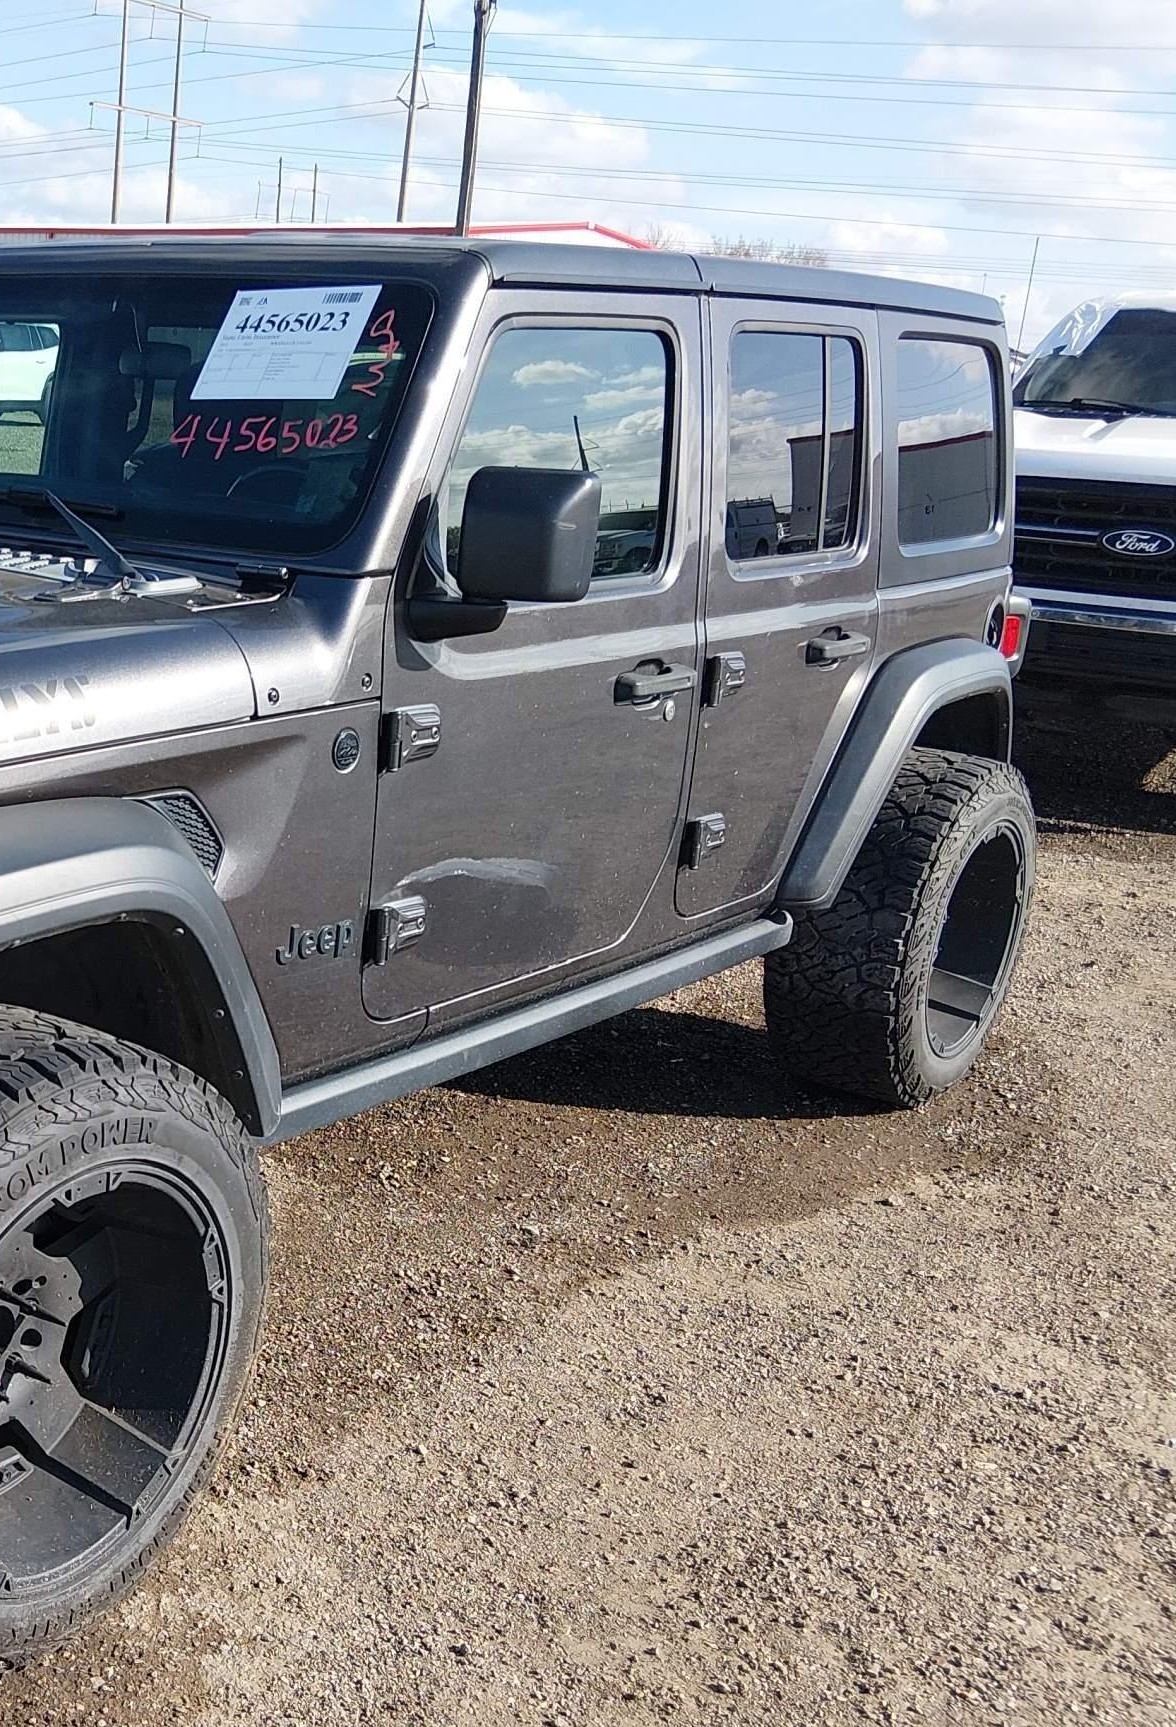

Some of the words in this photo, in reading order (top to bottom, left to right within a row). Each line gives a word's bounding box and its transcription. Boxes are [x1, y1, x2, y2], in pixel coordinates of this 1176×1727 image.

[235, 311, 350, 334] 44565023
[170, 413, 358, 460] 44565023
[1115, 532, 1161, 552] Ford
[276, 919, 355, 966] Jeep
[59, 1116, 159, 1167] POWER
